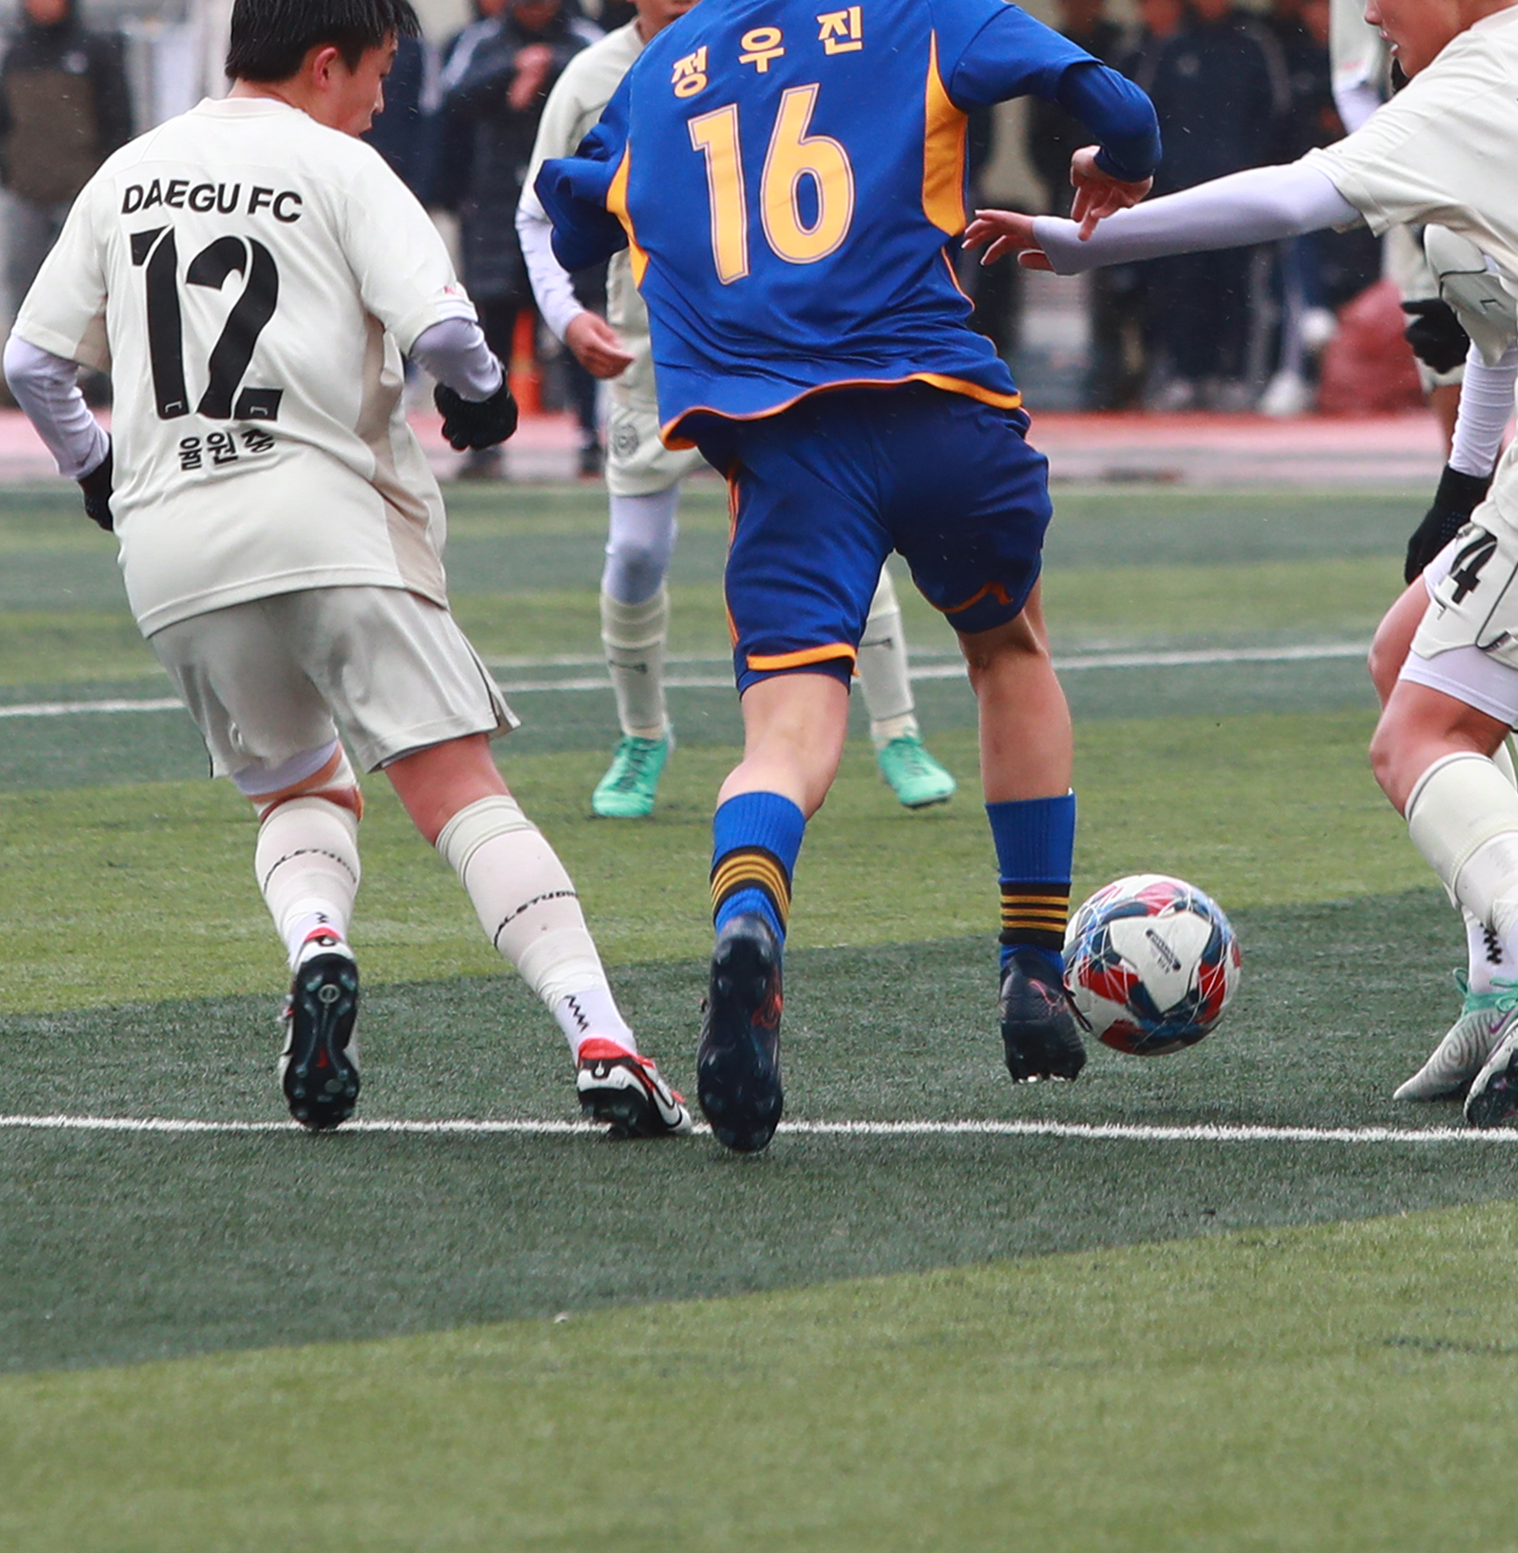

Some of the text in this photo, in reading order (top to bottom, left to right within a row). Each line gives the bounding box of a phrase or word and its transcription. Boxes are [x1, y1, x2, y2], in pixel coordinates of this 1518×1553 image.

[671, 5, 863, 99] 정우진
[121, 178, 302, 223] DAEGU FC
[687, 82, 856, 285] 16
[130, 225, 283, 421] 12
[178, 428, 275, 471] 율원중
